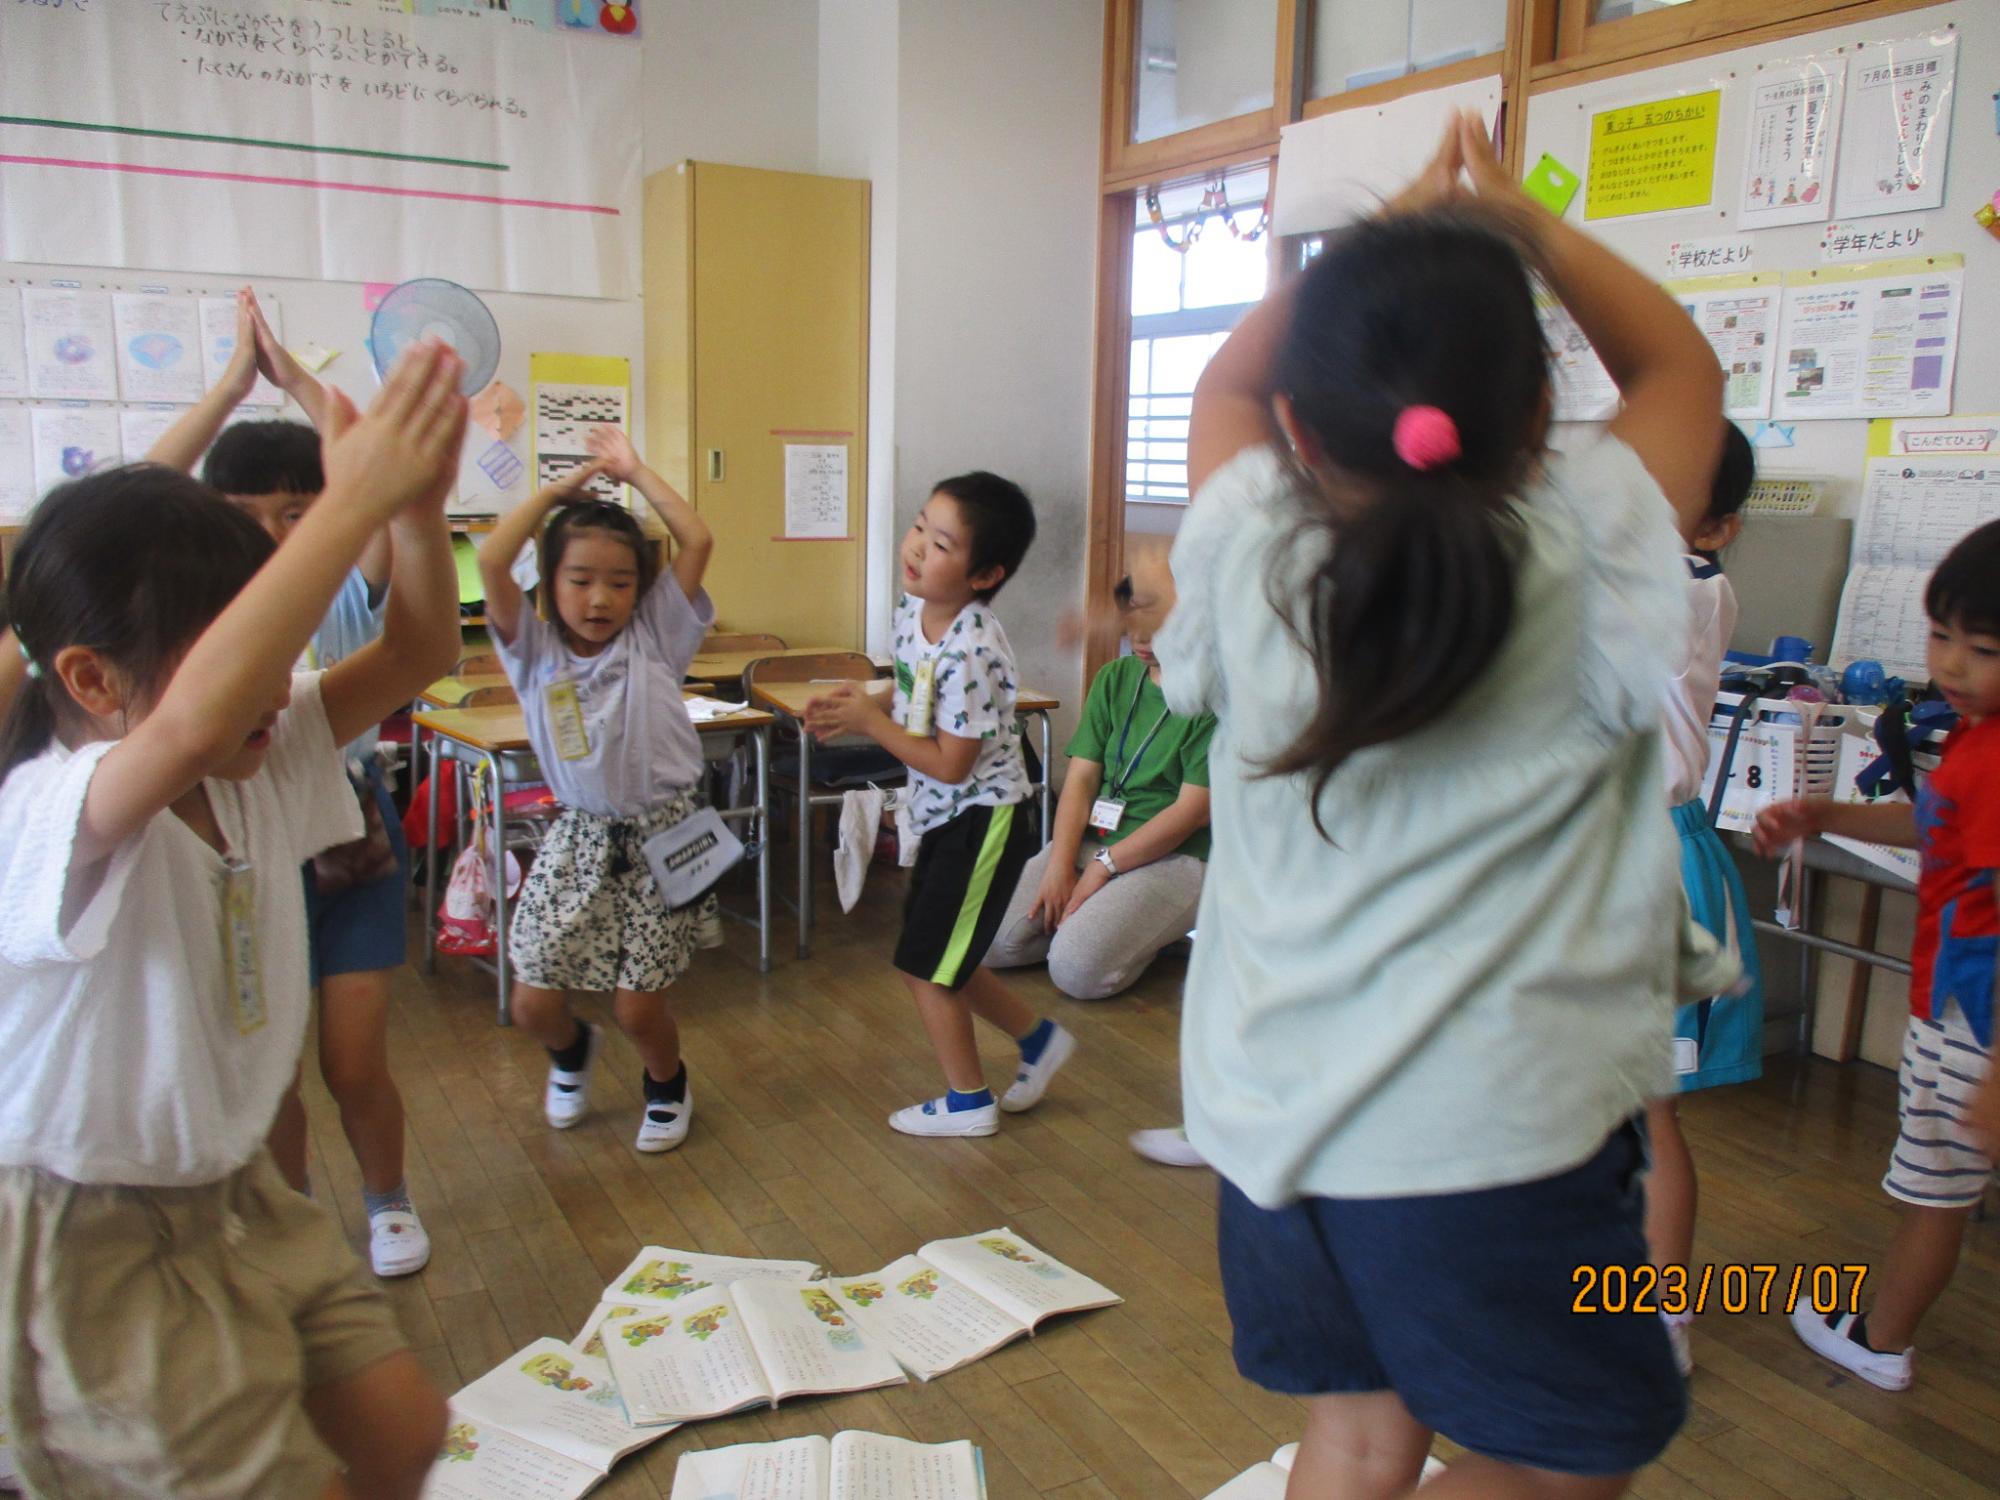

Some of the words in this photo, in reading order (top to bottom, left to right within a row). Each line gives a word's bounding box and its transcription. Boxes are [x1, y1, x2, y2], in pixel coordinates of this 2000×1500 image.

[1833, 228, 1920, 255] 学年だより
[1678, 245, 1750, 269] 学校だより
[1911, 435, 1987, 448] こんだてひょう
